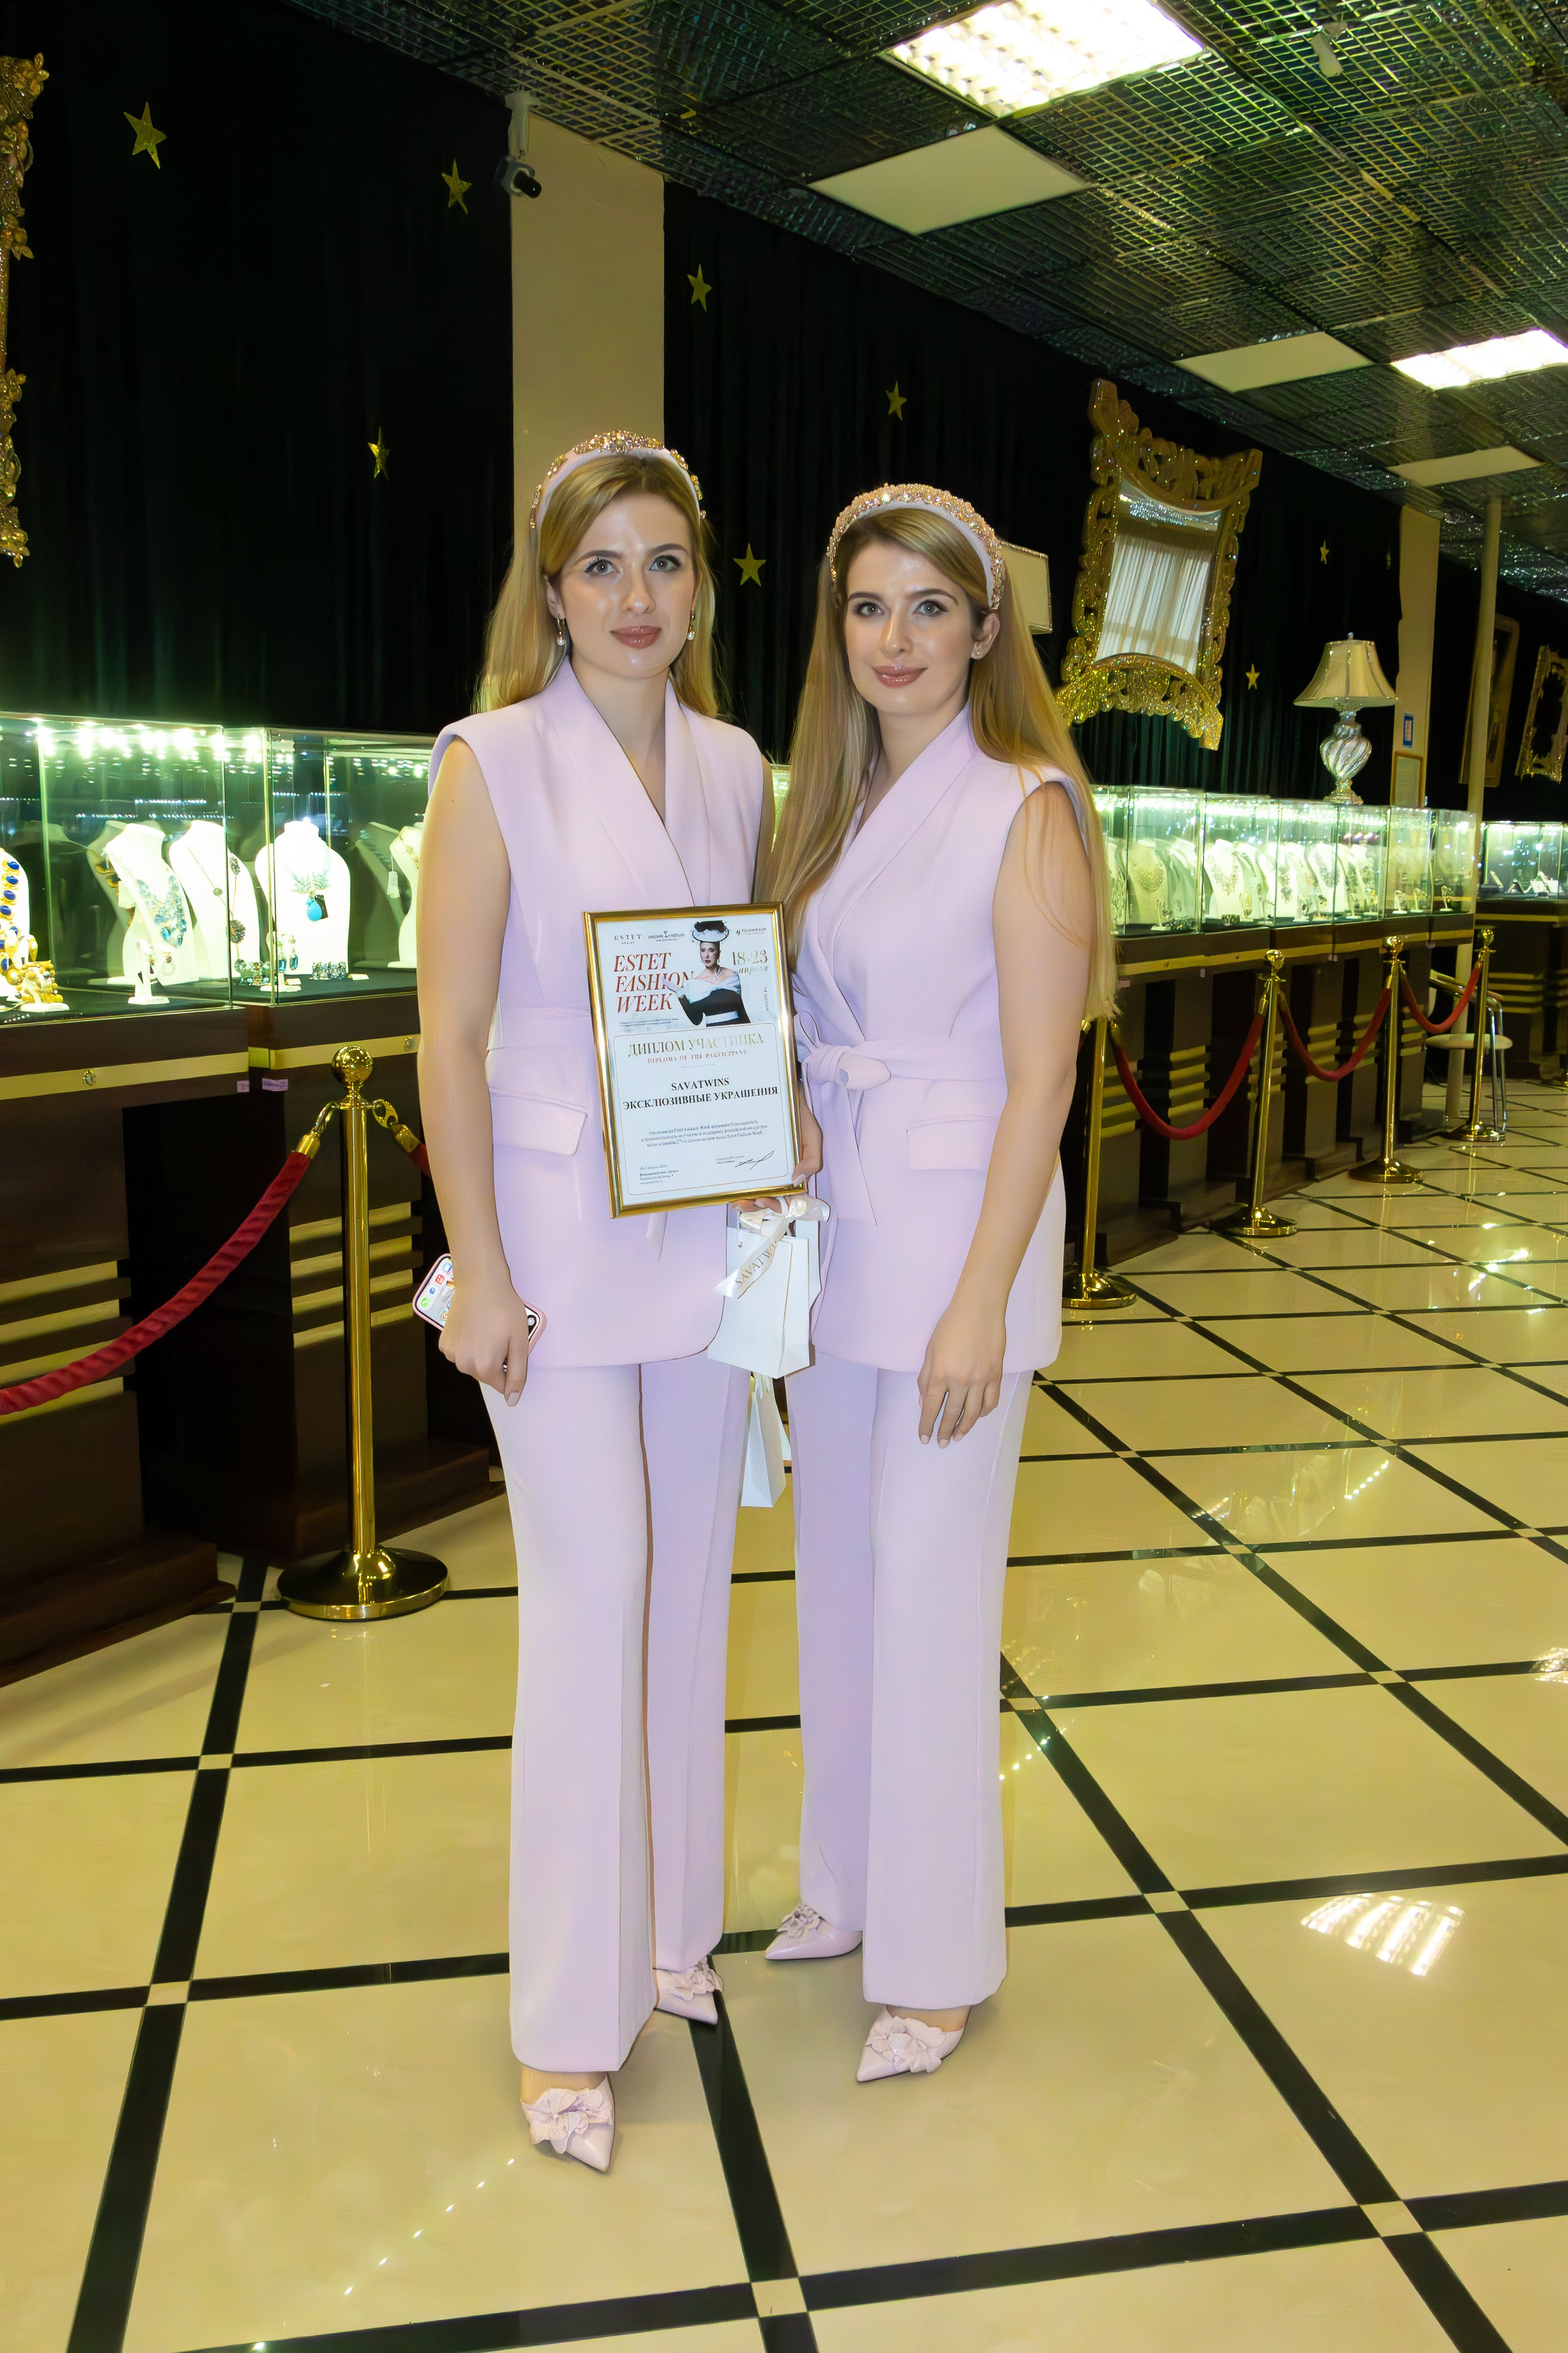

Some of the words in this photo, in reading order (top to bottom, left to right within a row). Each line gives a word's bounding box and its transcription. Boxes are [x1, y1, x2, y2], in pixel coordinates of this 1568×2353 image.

[614, 952, 671, 972] ESTET
[615, 971, 694, 993] FASHION
[617, 993, 673, 1013] WEEK
[628, 1041, 685, 1058] ДИПЛОМ
[688, 1033, 764, 1051] УЧАСТНИКА
[647, 1055, 677, 1064] DIPLOMA
[705, 1049, 747, 1058] PARTICIPANT
[671, 1078, 730, 1091] SAVATWINS
[622, 1093, 712, 1110] ЭКСКЛЮЗИВНЫЕ
[714, 1086, 778, 1101] УКРАШЕНИЯ
